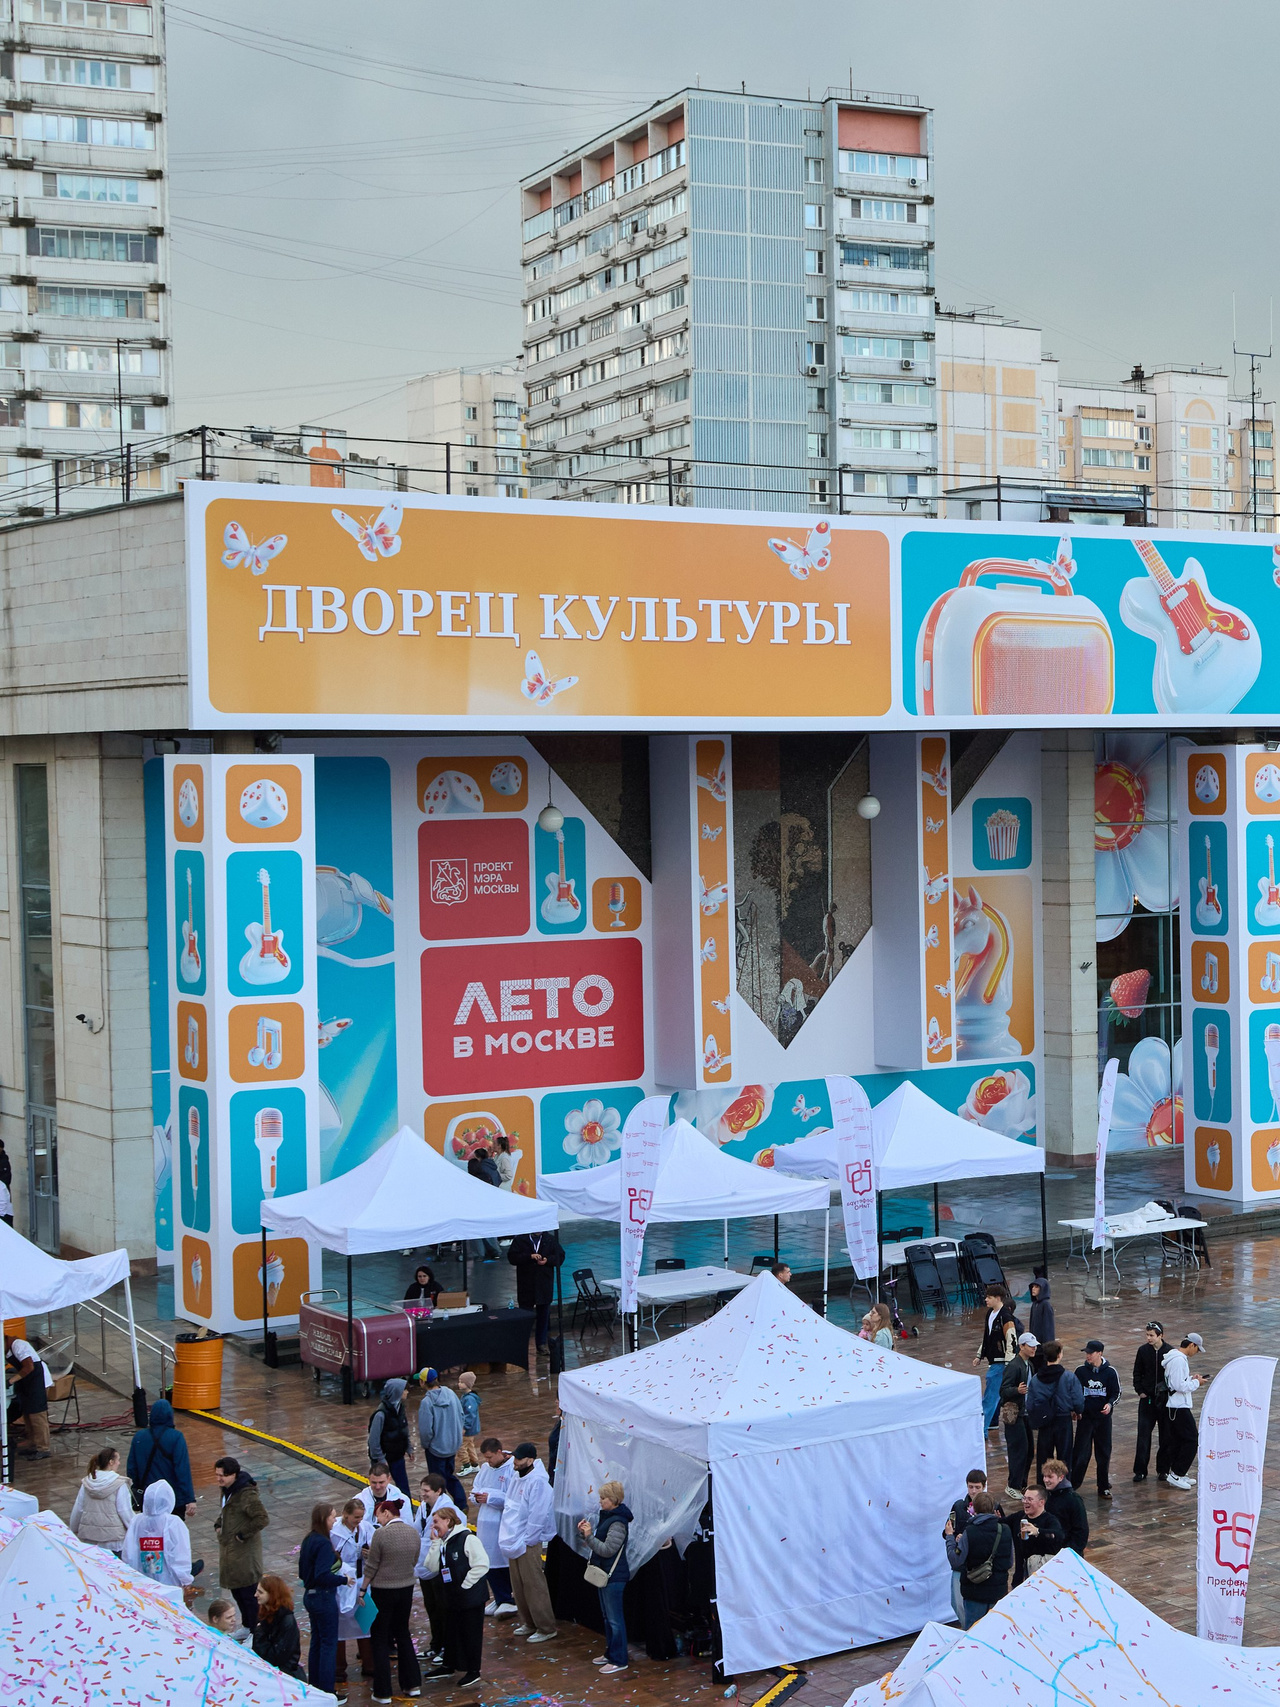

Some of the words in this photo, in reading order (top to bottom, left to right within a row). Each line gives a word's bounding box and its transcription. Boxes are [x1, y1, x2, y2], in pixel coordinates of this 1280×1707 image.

[258, 583, 520, 648] ДВОРЕЦ
[539, 593, 852, 646] КУЛЬТУРЫ
[473, 861, 514, 872] ПРОЕКТ
[473, 872, 503, 883] МЭРА
[473, 883, 519, 895] МОСКВЫ
[453, 974, 615, 1026] ЛЕТО
[453, 1036, 474, 1059] В
[485, 1026, 615, 1056] МОСКВЕ
